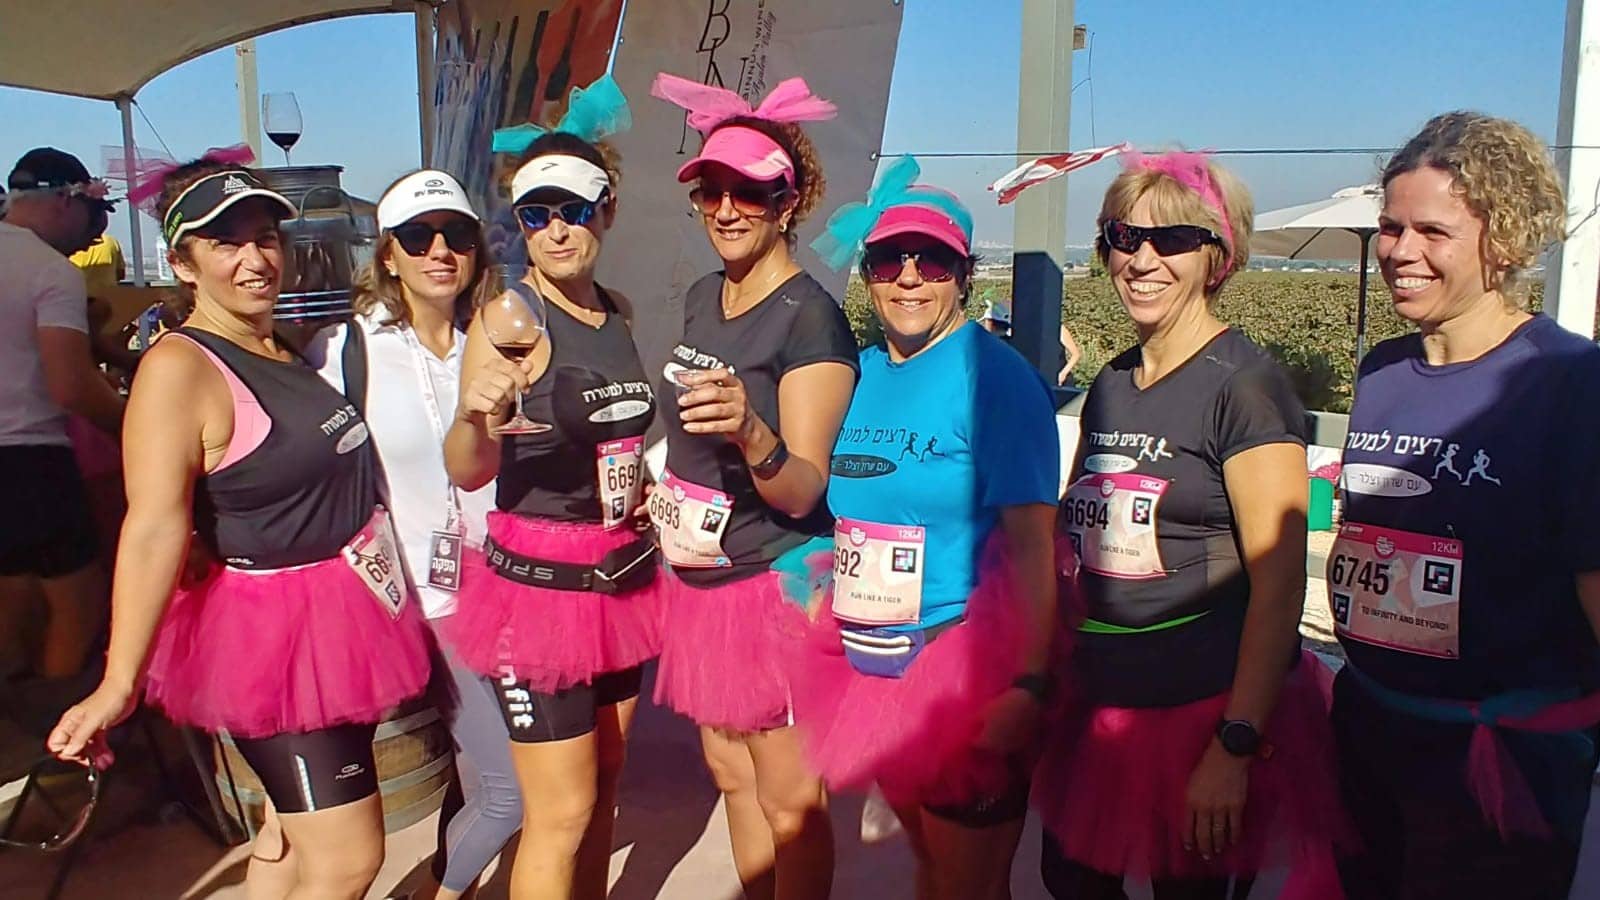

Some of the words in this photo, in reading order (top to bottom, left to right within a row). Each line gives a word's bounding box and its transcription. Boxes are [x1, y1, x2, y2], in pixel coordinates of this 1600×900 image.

[582, 382, 622, 402] למטרה
[840, 425, 870, 444] למטר
[872, 428, 906, 444] רצים
[1119, 433, 1147, 447] רצים
[1347, 430, 1391, 452] למטר
[1394, 435, 1443, 457] רצים
[1407, 479, 1422, 491] עם
[651, 493, 680, 530] 6693
[1065, 498, 1109, 531] 6694
[1332, 554, 1389, 596] 6745
